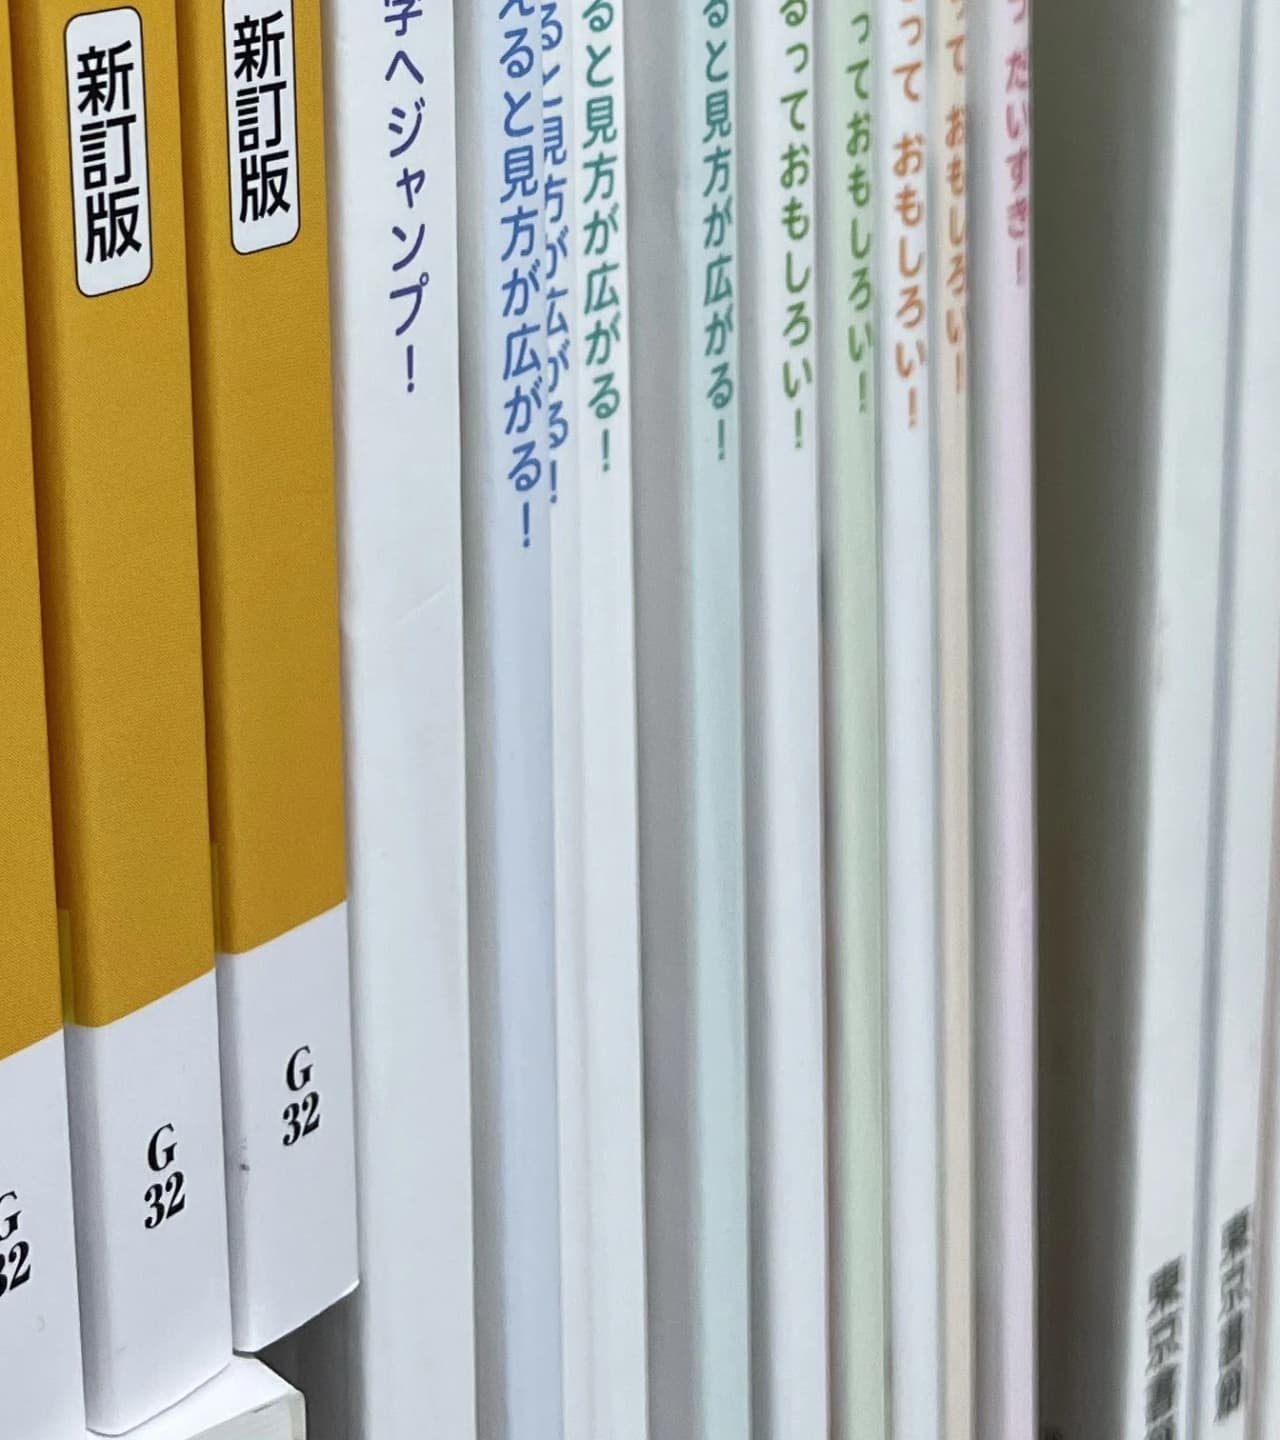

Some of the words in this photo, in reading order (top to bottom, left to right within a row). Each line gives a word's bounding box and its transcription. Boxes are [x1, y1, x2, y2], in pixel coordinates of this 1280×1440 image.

[232, 10, 291, 222] 新訂版
[76, 40, 142, 264] 新訂版
[285, 1045, 312, 1093] G
[282, 1090, 321, 1146] 32
[144, 1123, 178, 1172] G
[143, 1171, 186, 1230] 32
